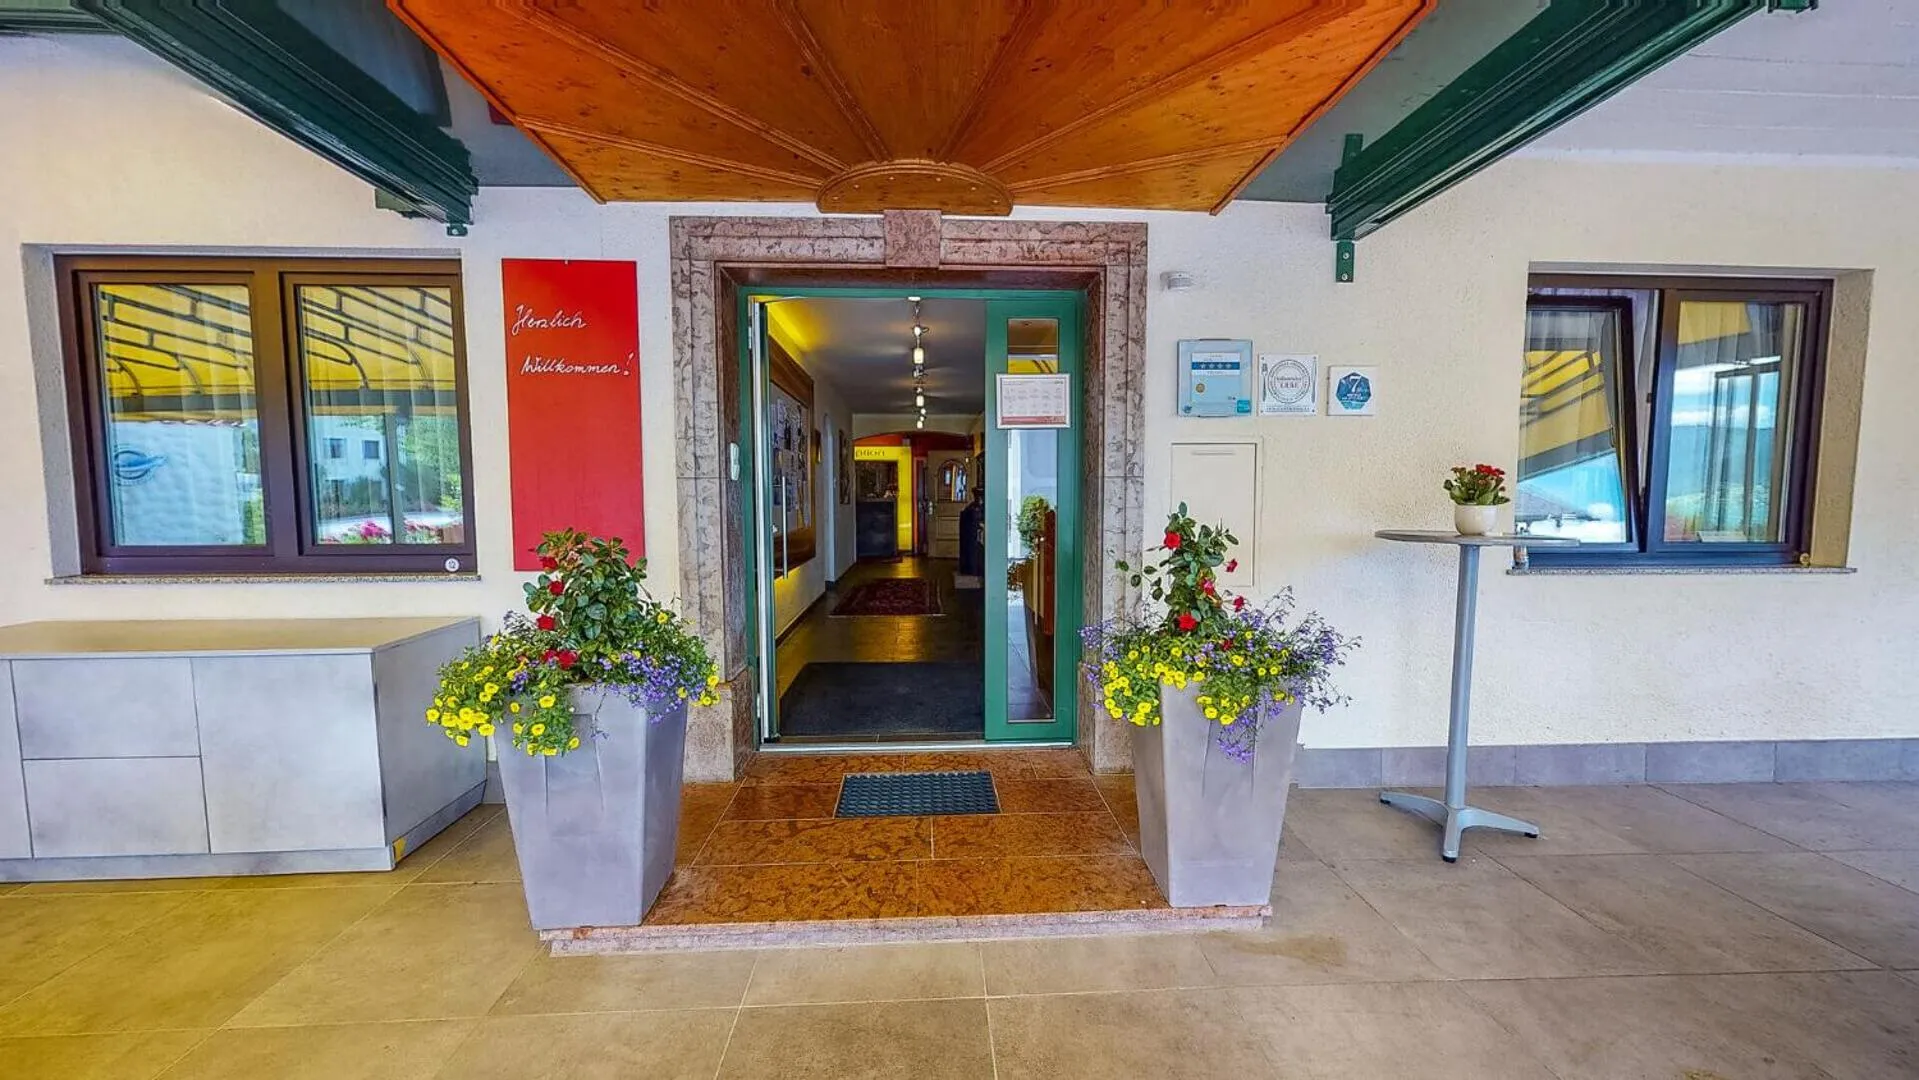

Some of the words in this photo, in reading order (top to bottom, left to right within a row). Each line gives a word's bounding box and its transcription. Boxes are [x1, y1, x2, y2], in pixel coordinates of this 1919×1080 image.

[511, 304, 588, 336] Herzlich
[520, 352, 634, 376] Willkommen!
[1350, 375, 1362, 393] 7
